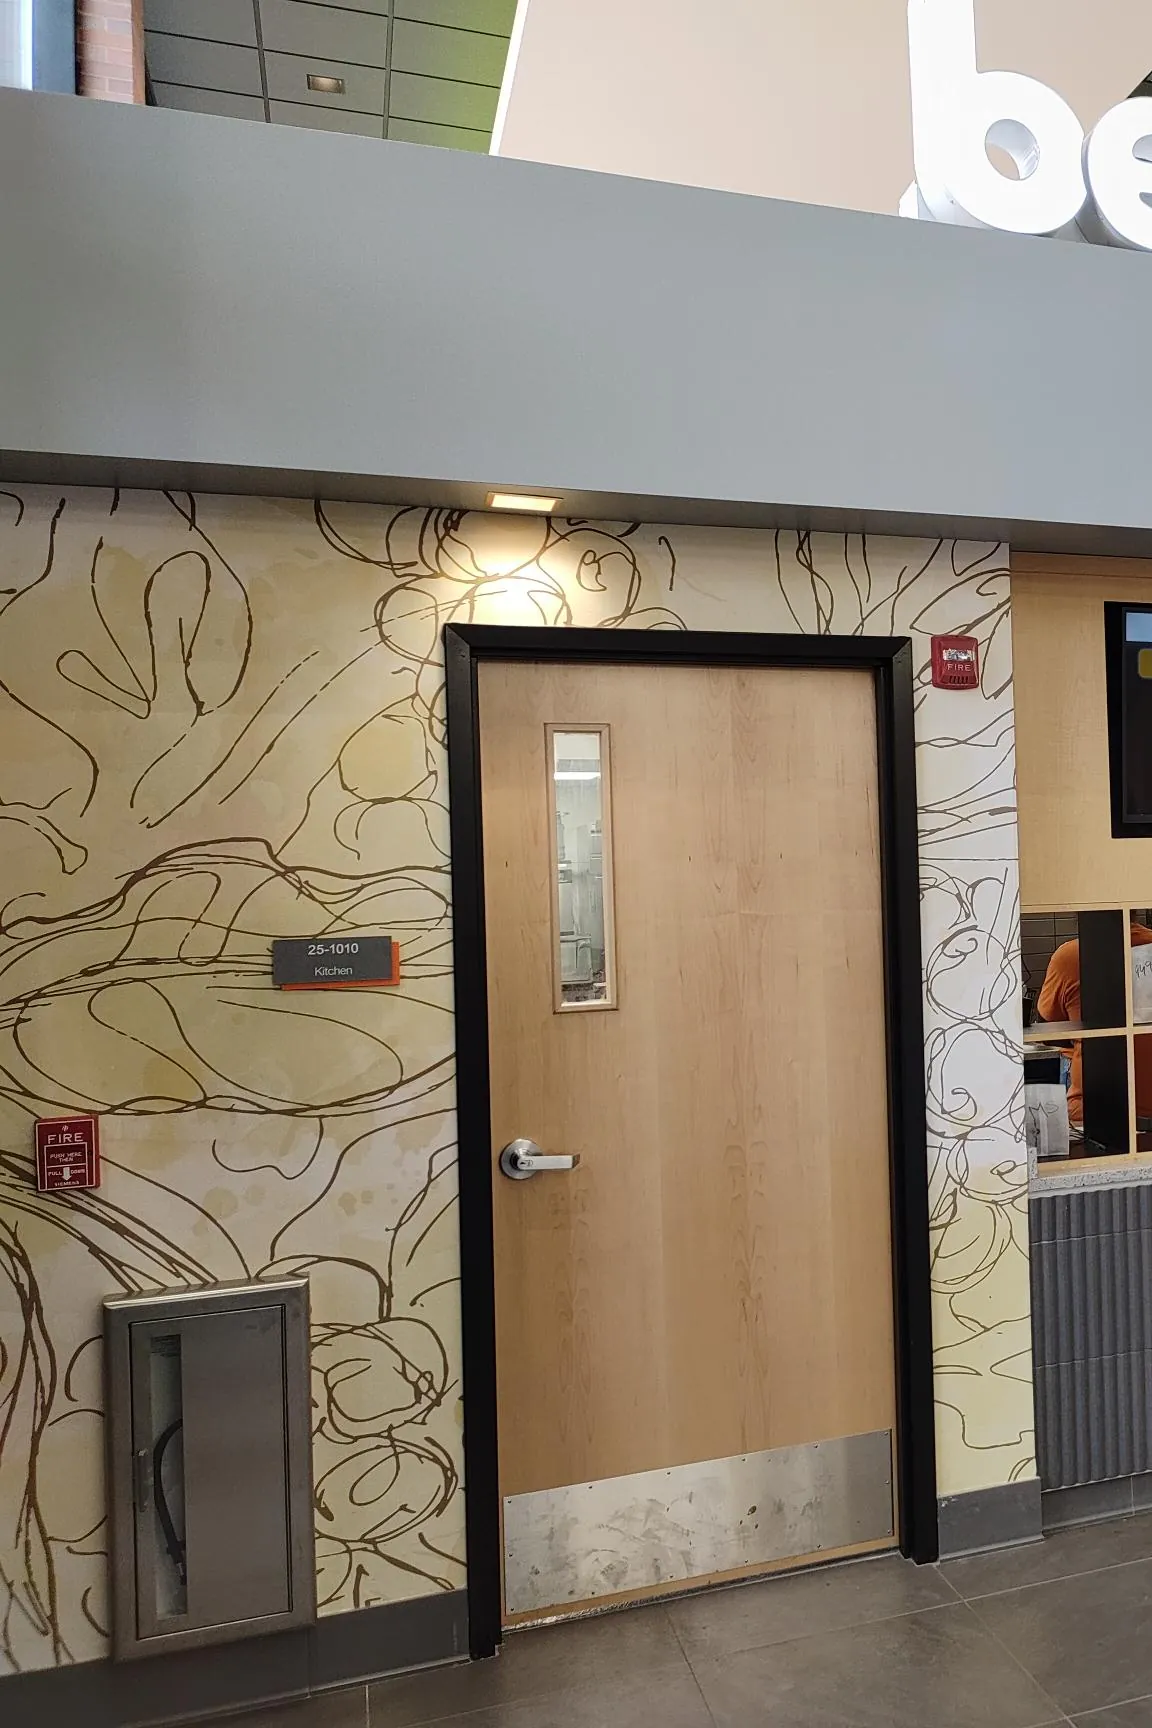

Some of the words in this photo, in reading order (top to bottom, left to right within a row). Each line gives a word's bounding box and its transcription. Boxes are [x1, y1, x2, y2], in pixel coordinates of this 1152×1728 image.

[308, 943, 359, 956] 25-1010
[314, 966, 352, 976] Kitchen
[48, 1132, 84, 1144] FIRE
